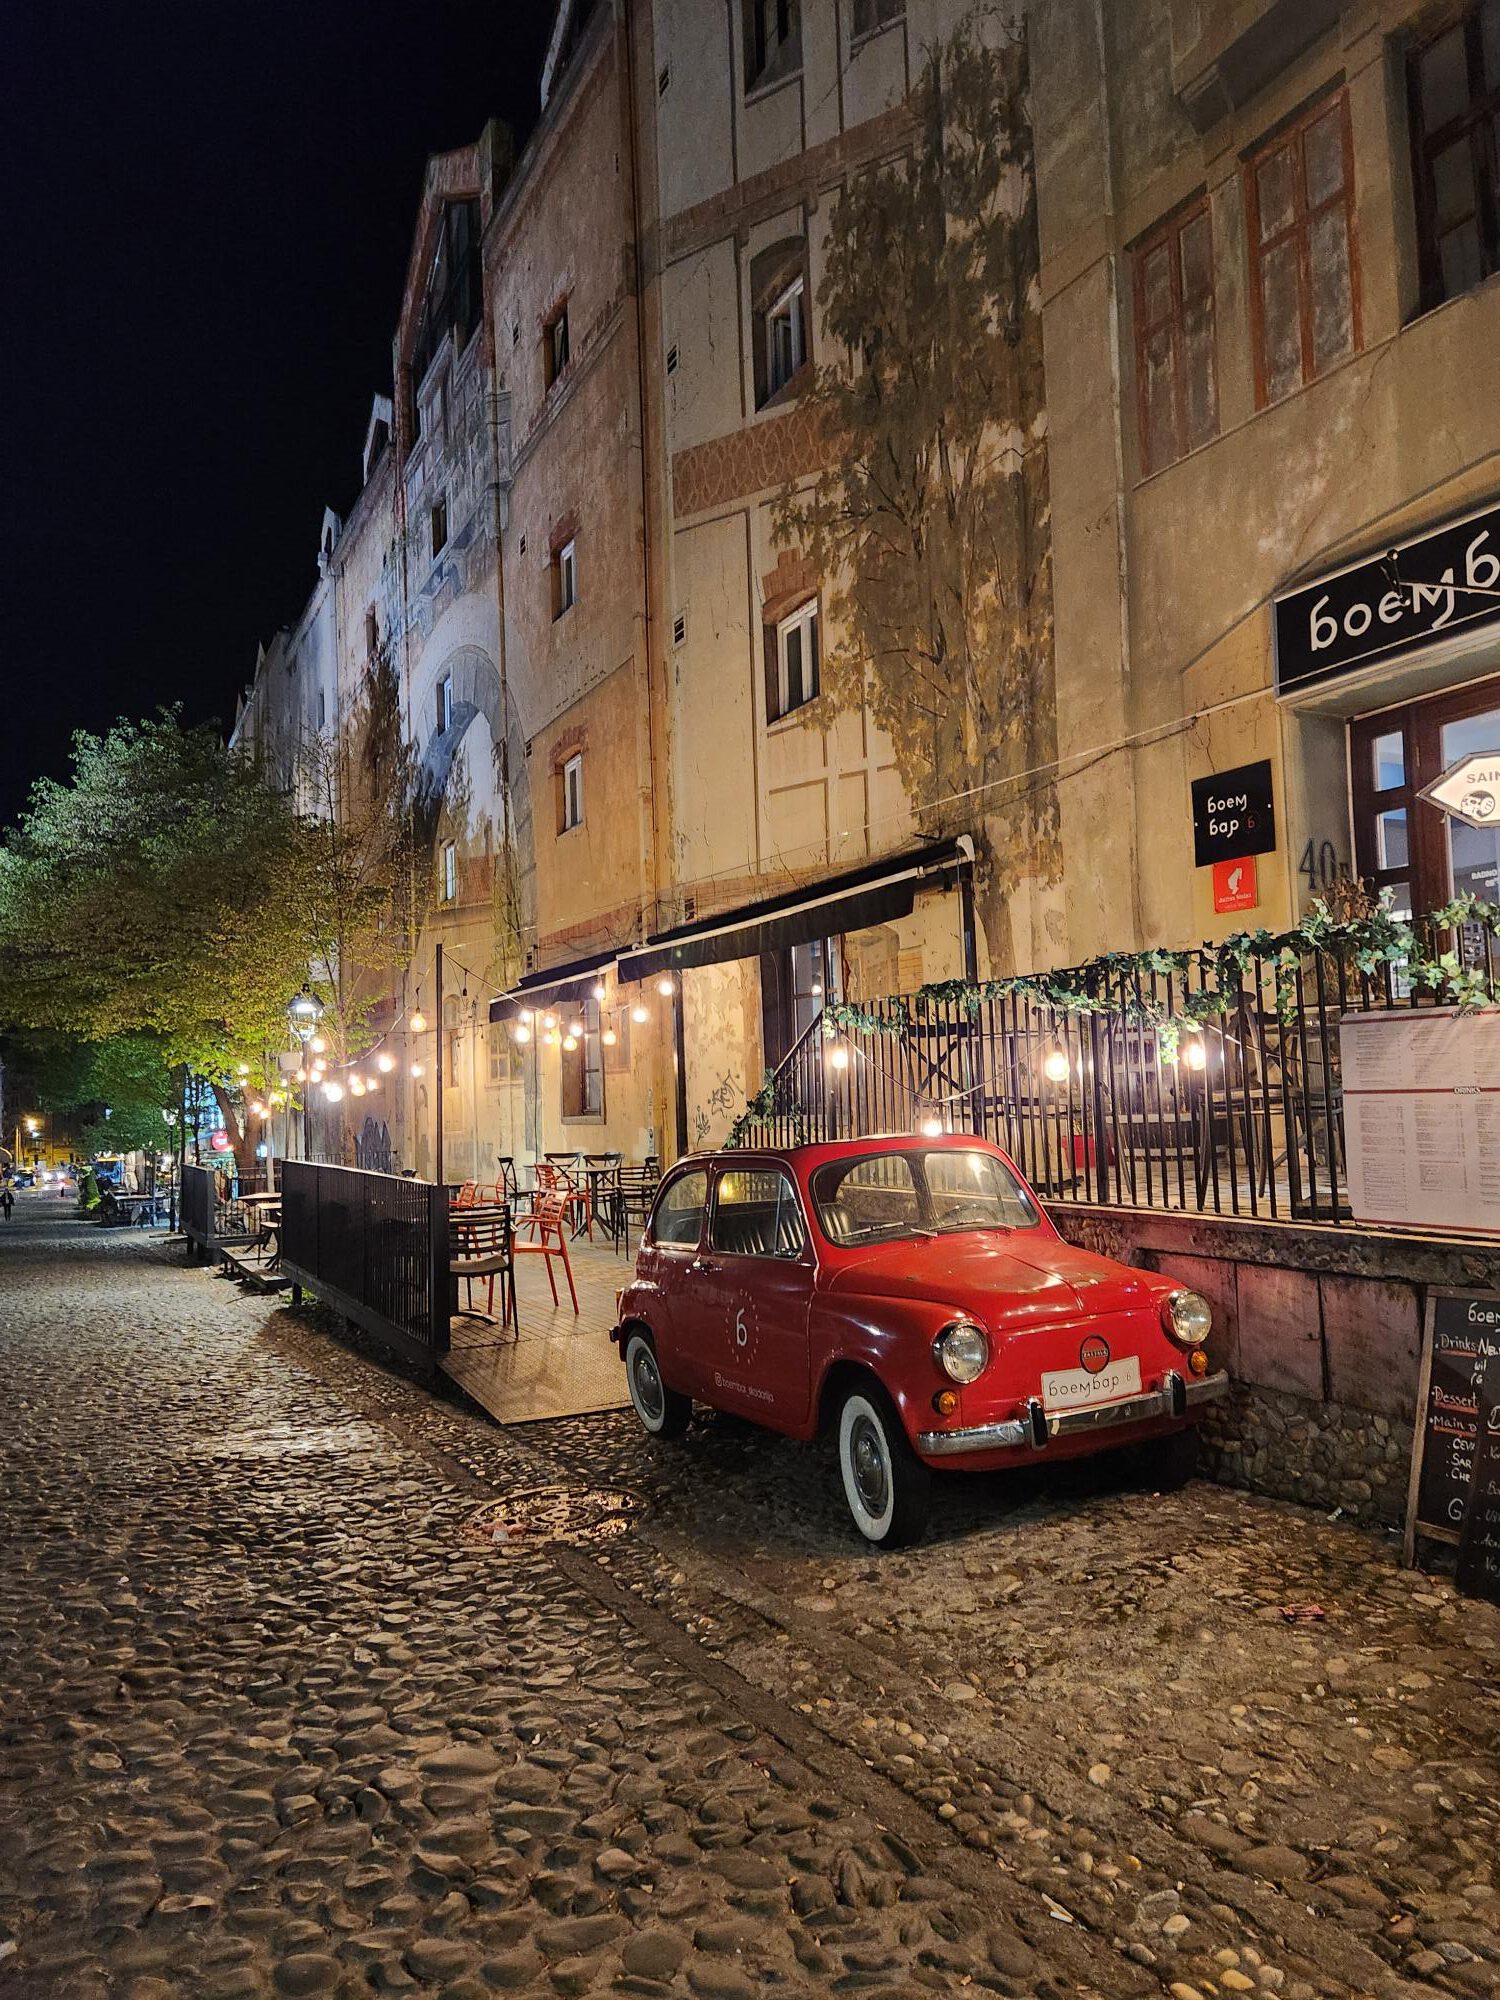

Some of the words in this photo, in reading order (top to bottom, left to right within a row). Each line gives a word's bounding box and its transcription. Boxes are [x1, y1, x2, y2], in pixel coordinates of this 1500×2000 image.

[1207, 794, 1247, 813] боем
[1209, 818, 1239, 838] бар
[1049, 1374, 1119, 1398] боембар
